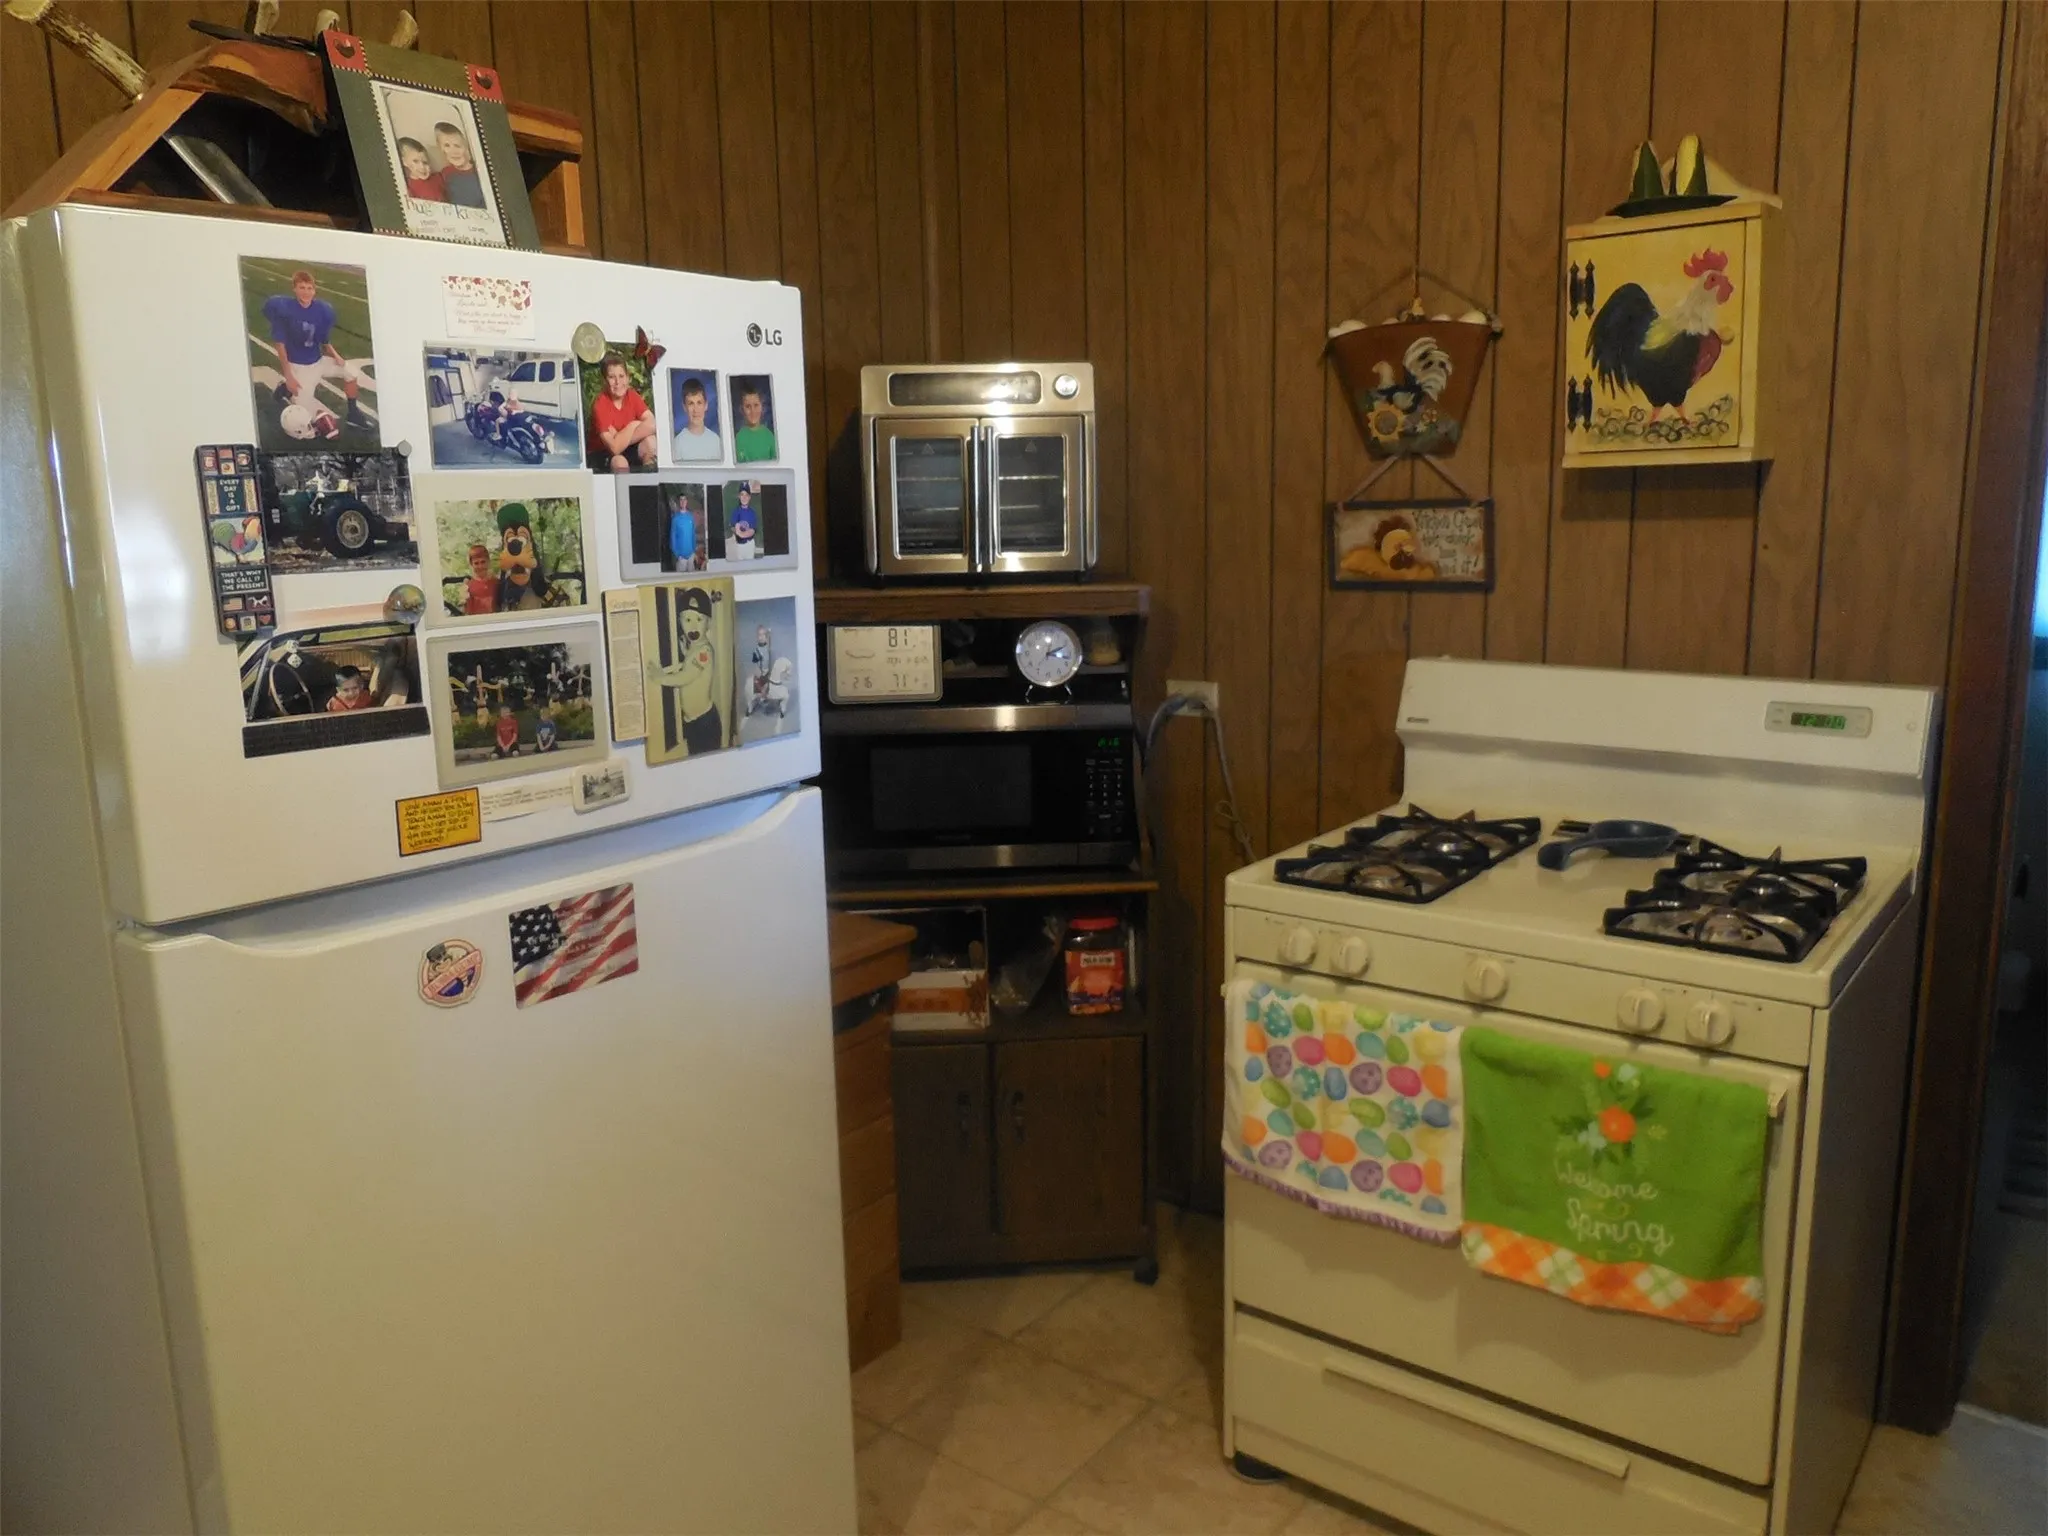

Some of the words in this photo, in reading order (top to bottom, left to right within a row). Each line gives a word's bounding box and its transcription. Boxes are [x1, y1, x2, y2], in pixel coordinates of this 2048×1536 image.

[766, 329, 782, 346] LG
[236, 582, 265, 590] PRESENT
[1554, 1157, 1659, 1198] Welcome
[1567, 1198, 1674, 1257] Spring
